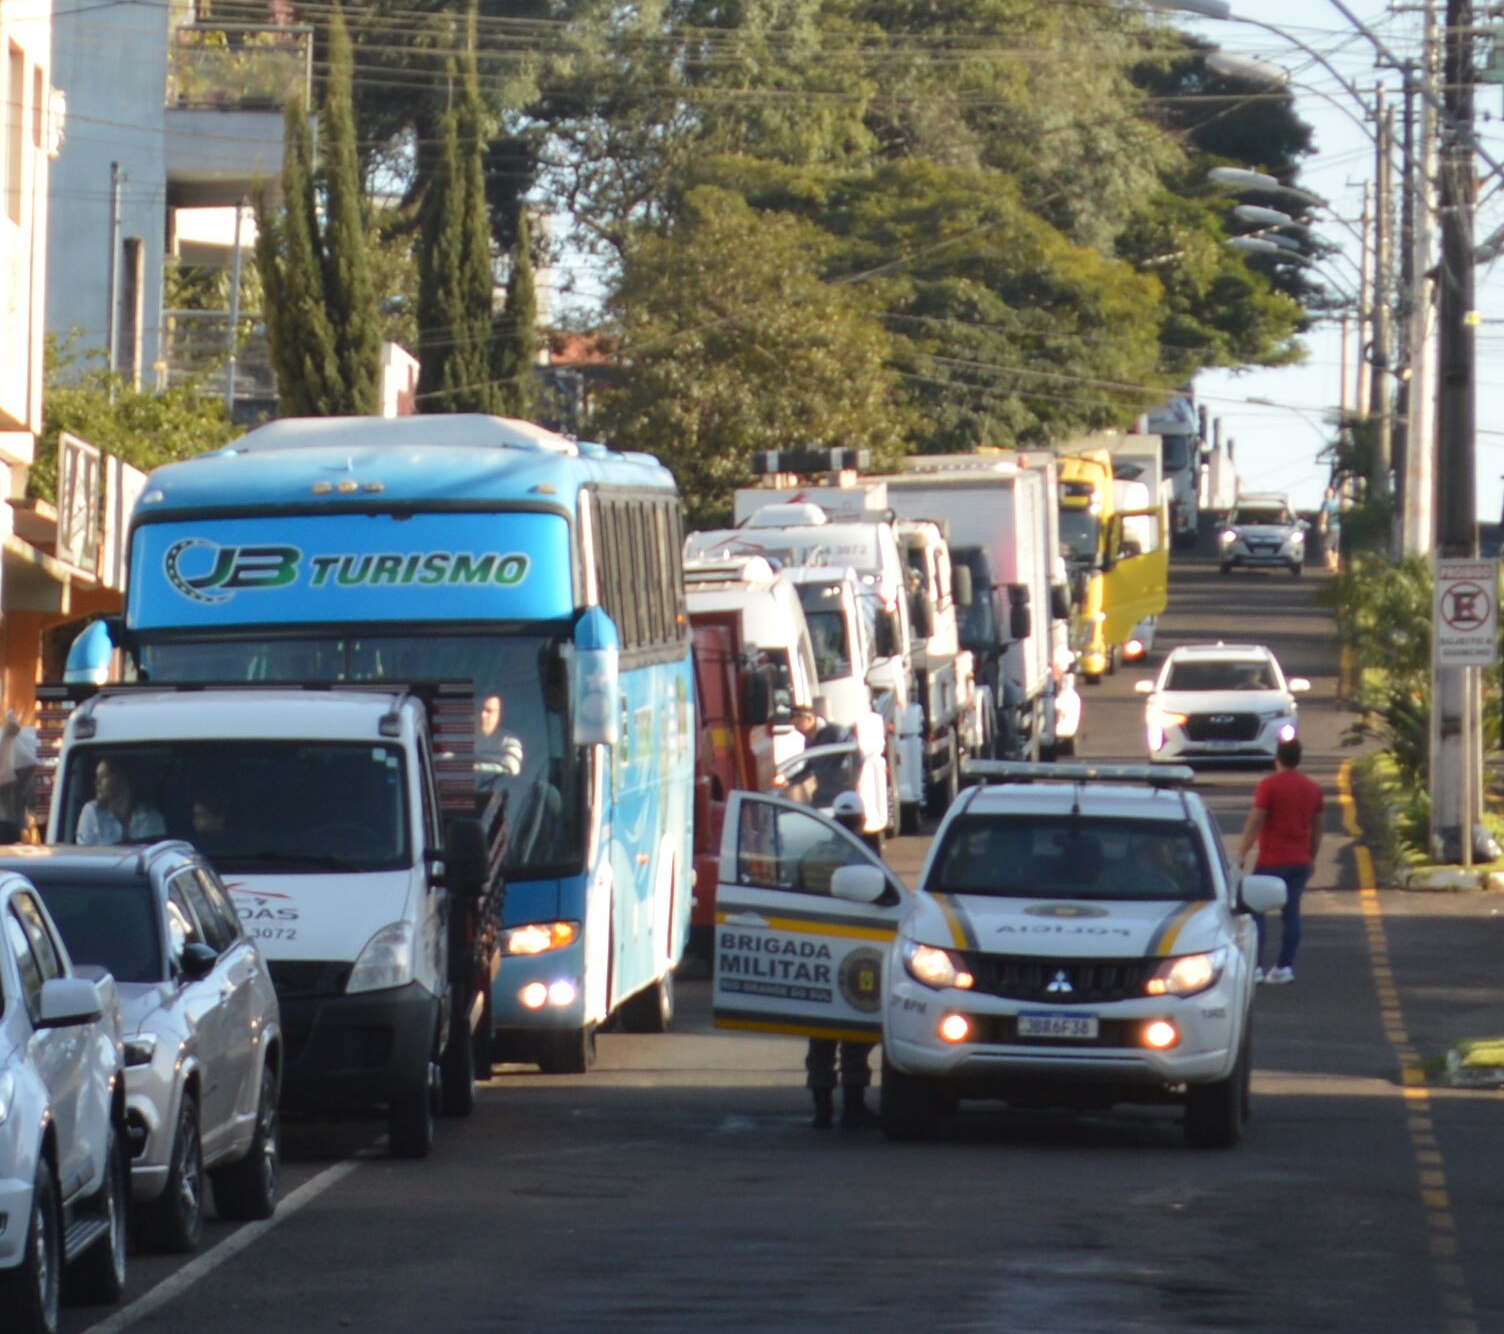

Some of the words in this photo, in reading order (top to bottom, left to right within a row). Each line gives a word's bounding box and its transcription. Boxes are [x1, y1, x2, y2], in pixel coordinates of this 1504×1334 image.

[310, 552, 530, 587] TURISMO
[720, 933, 832, 960] BRIGADA
[719, 954, 831, 983] MILITAR
